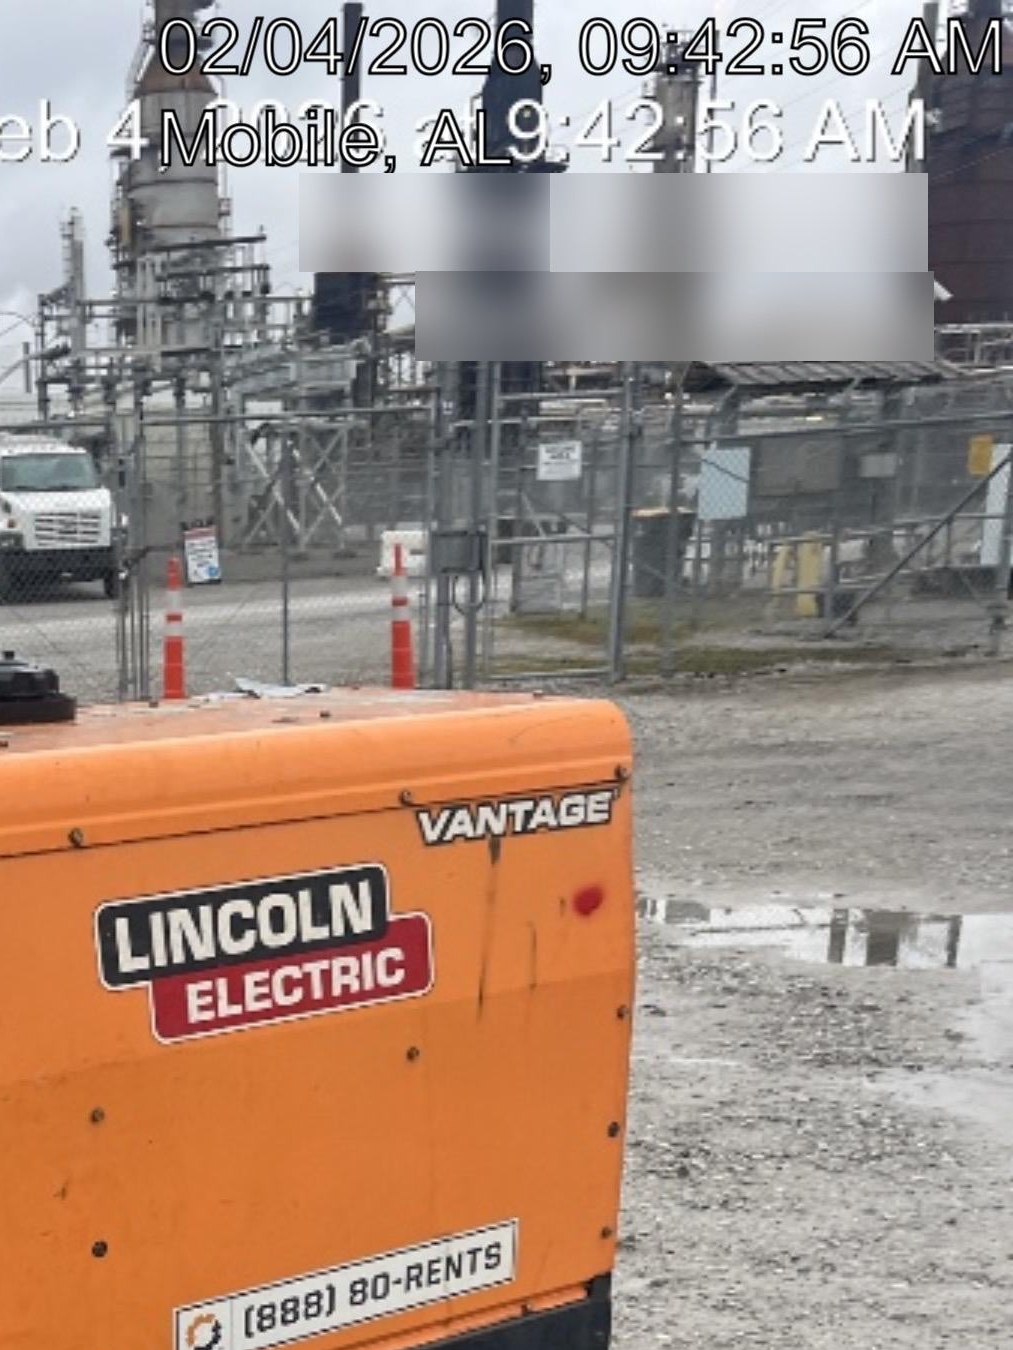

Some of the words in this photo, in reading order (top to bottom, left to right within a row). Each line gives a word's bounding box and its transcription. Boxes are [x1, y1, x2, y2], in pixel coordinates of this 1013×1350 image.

[417, 790, 613, 844] VANTAGE
[115, 878, 374, 973] LINCOLN
[186, 947, 407, 1024] ELECTRIC
[244, 1283, 337, 1338] (888)
[349, 1242, 502, 1306] 80-RENTS
